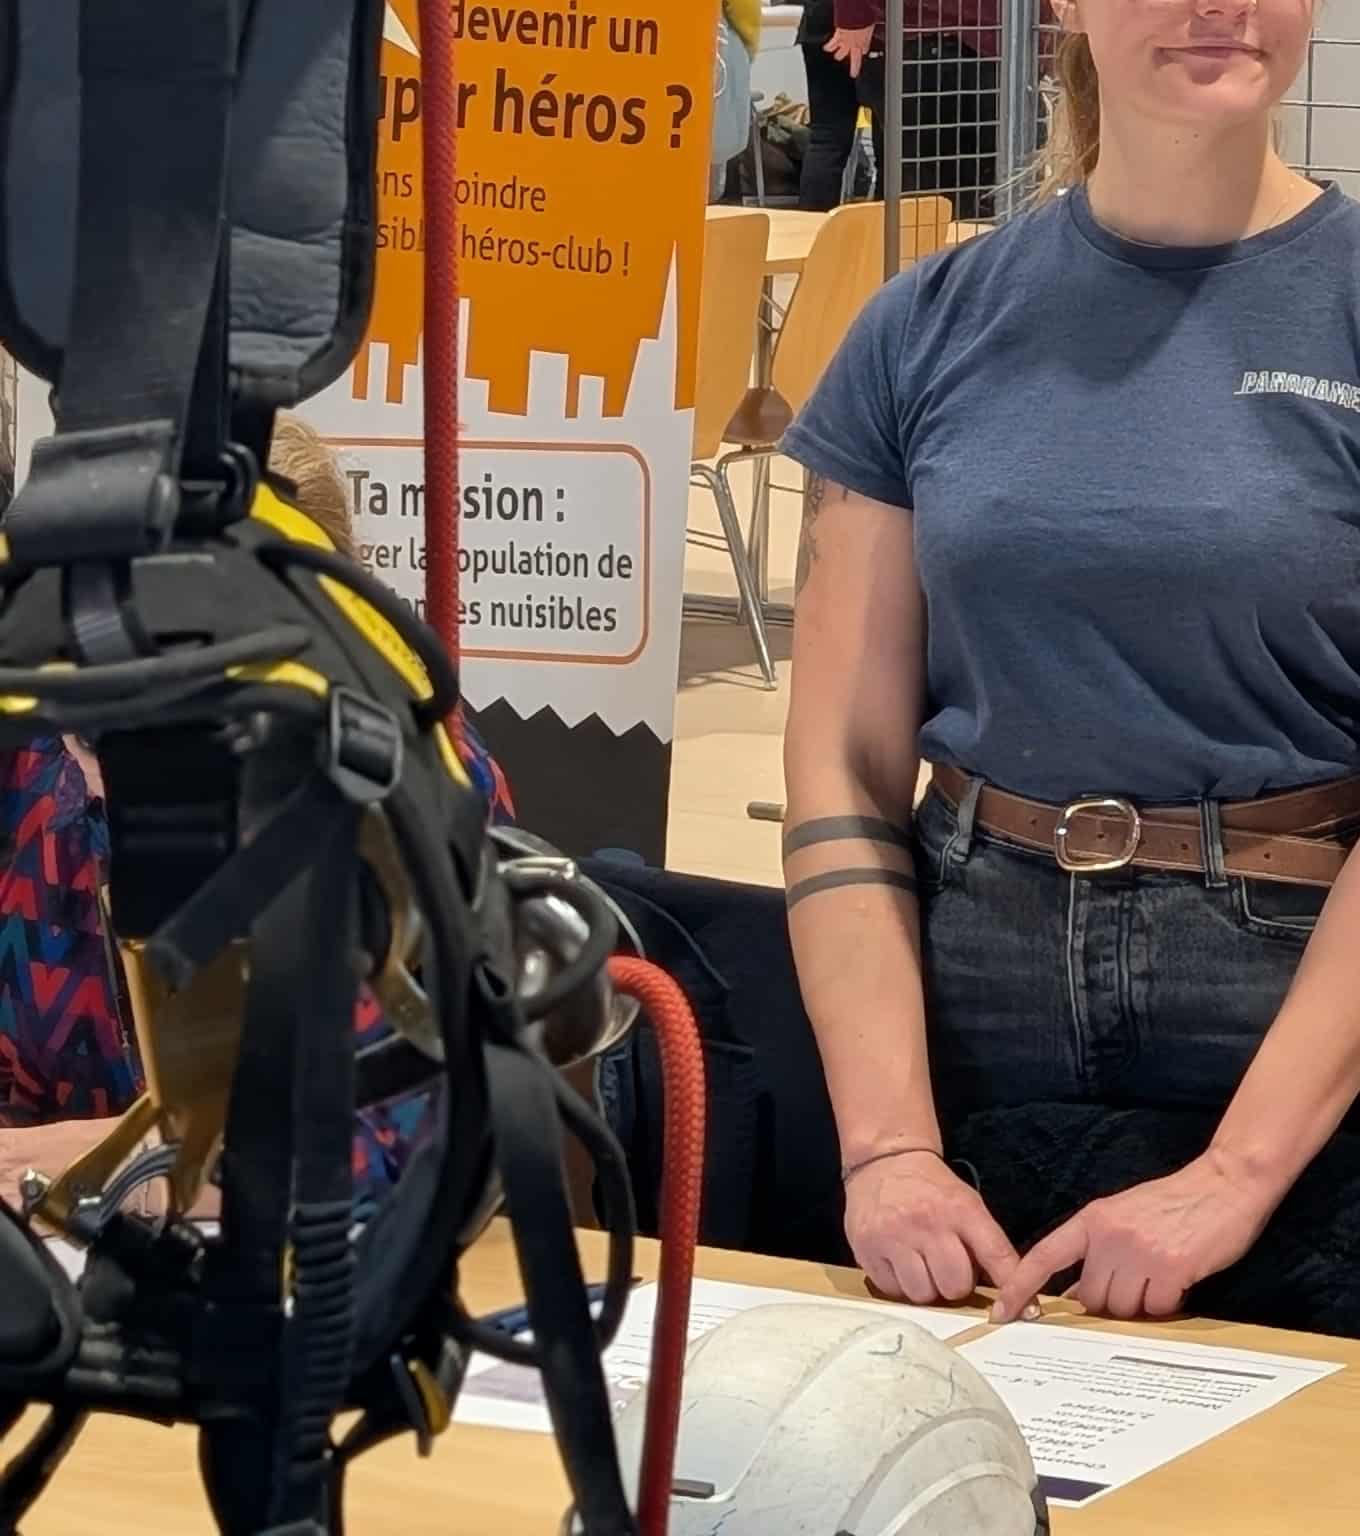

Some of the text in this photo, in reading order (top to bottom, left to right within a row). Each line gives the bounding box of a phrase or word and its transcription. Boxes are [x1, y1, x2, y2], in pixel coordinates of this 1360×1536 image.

[608, 15, 659, 56] un
[493, 67, 647, 145] héros
[460, 223, 613, 274] héros-club
[345, 470, 388, 517] Ta
[456, 540, 589, 583] opulation
[598, 544, 633, 580] de
[490, 593, 618, 632] nuisibles
